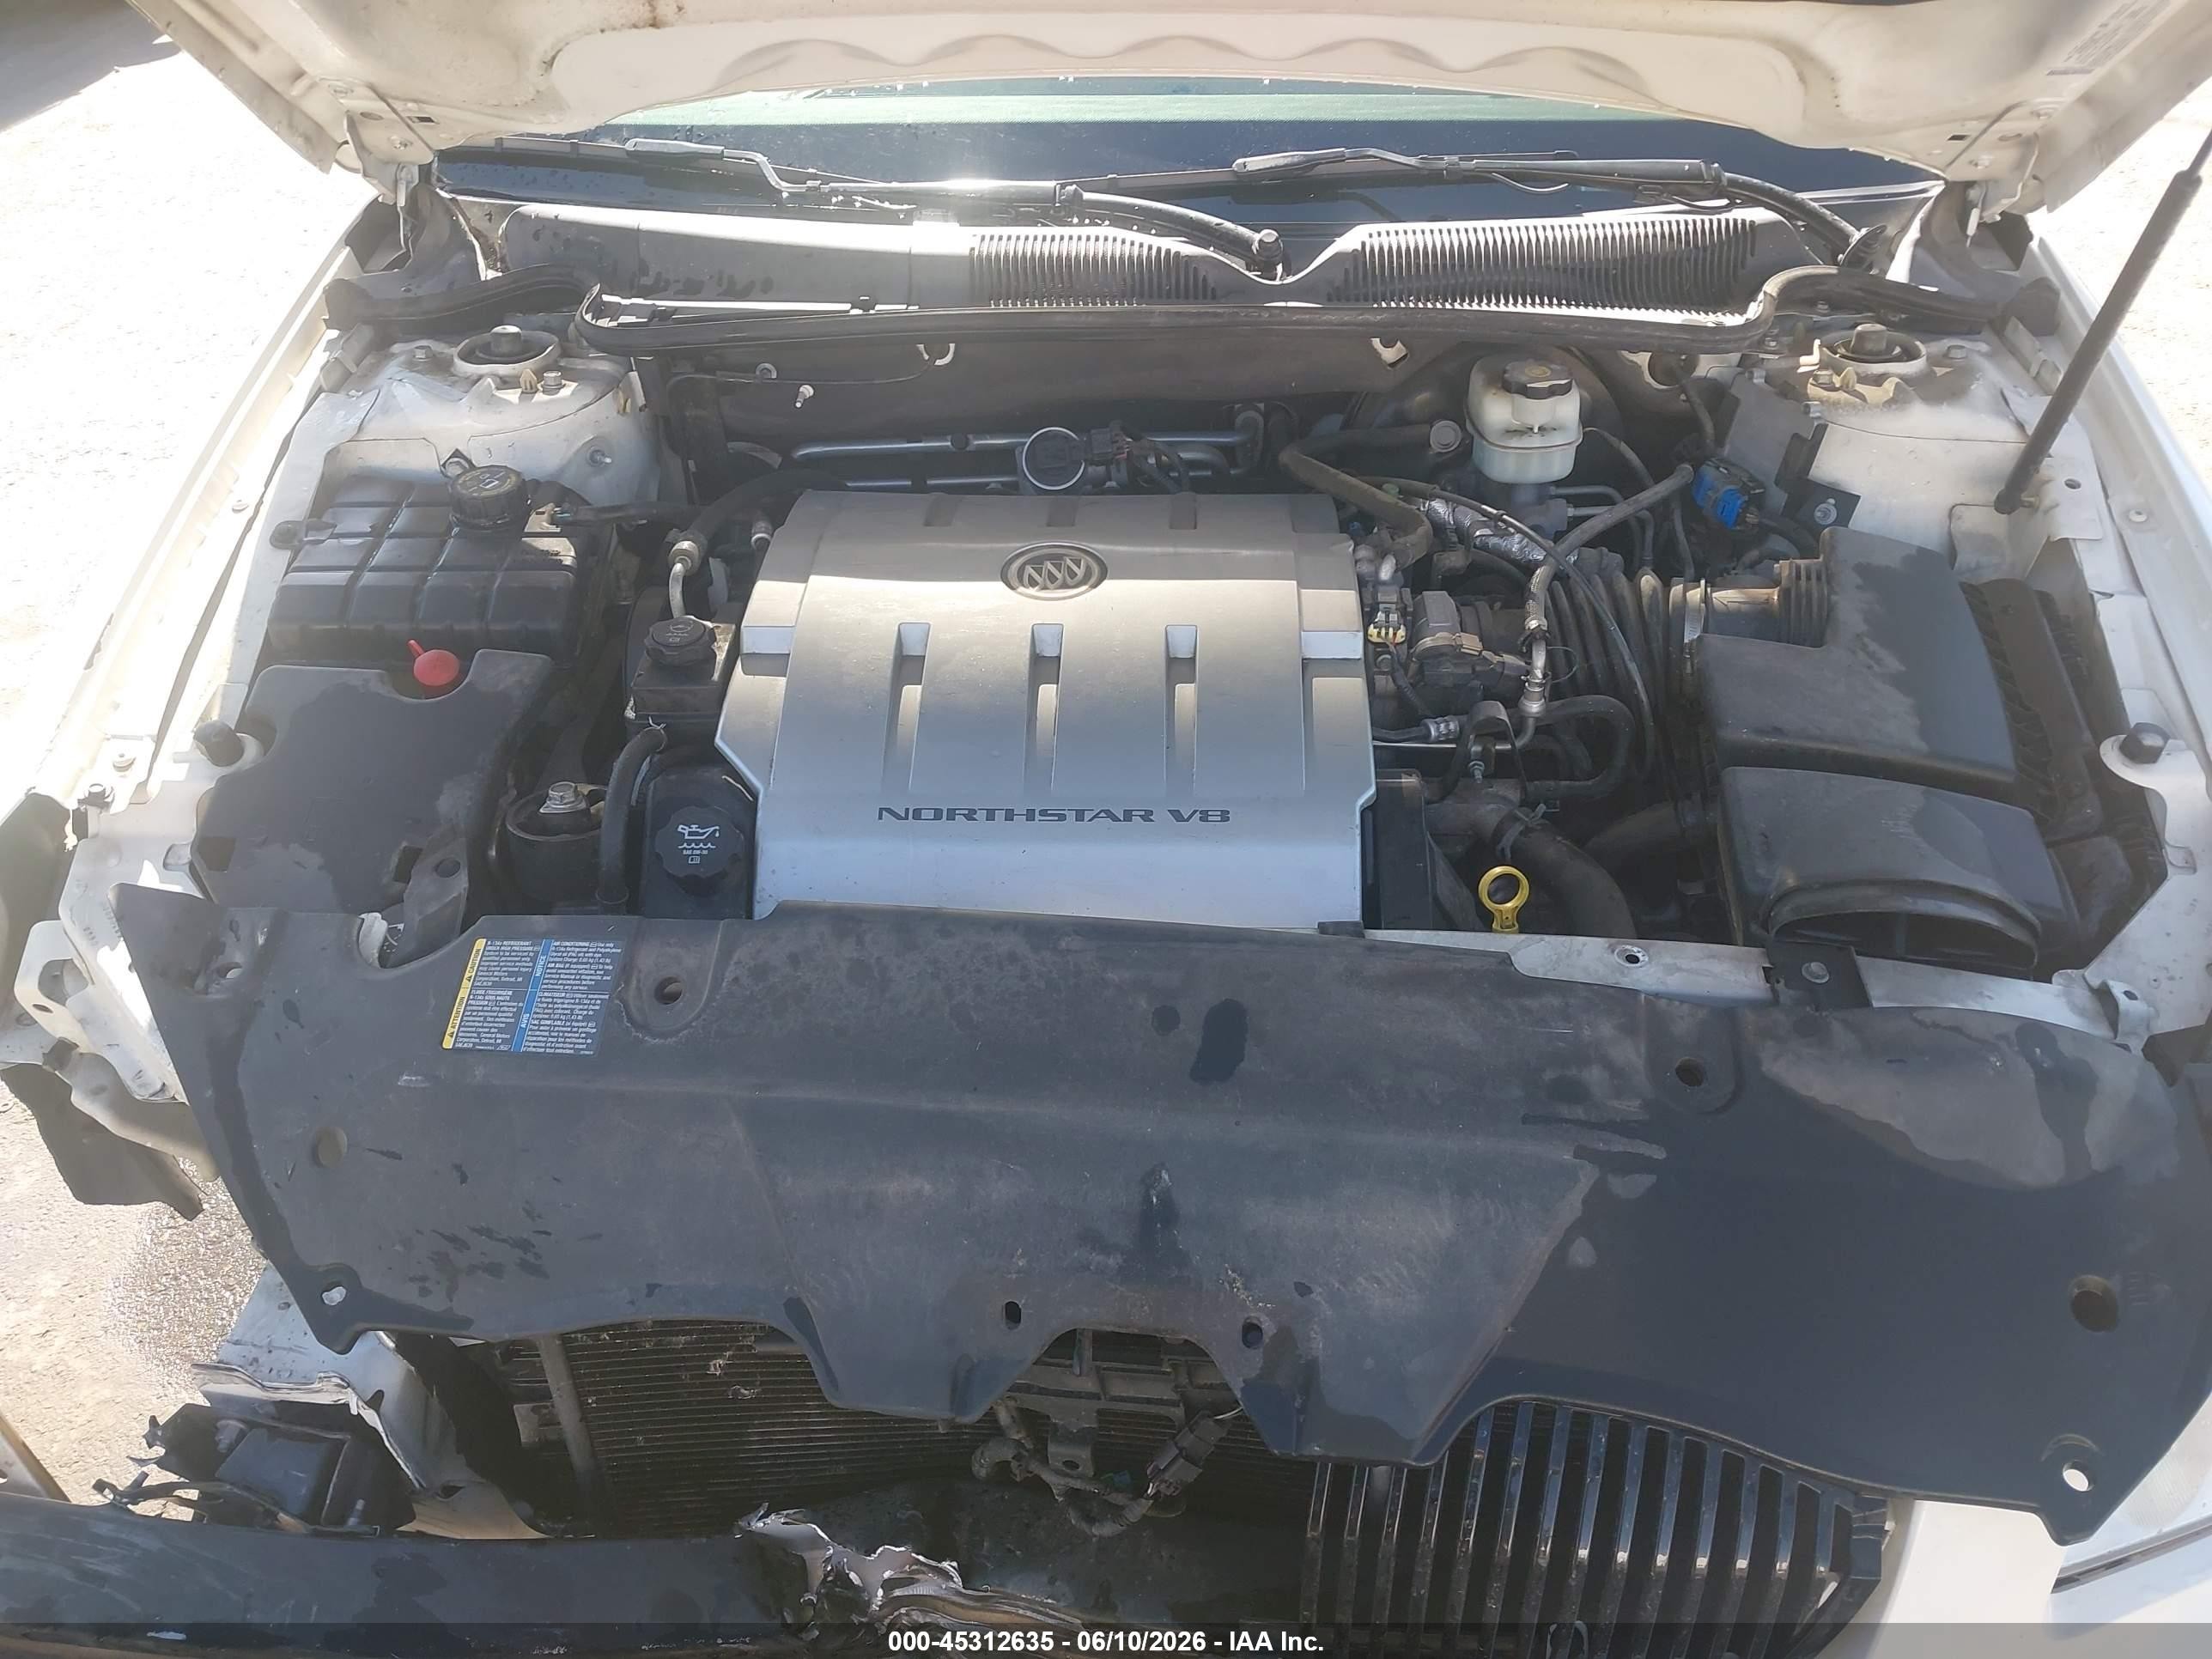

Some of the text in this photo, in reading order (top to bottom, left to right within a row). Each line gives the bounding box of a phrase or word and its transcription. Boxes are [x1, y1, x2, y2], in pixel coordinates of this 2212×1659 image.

[878, 806, 1231, 823] NORTHSTAR V8
[468, 948, 482, 974] CAUTION
[535, 955, 547, 976] NOTICE
[451, 996, 465, 1030] ATTENTION
[520, 1013, 530, 1029] AVIS
